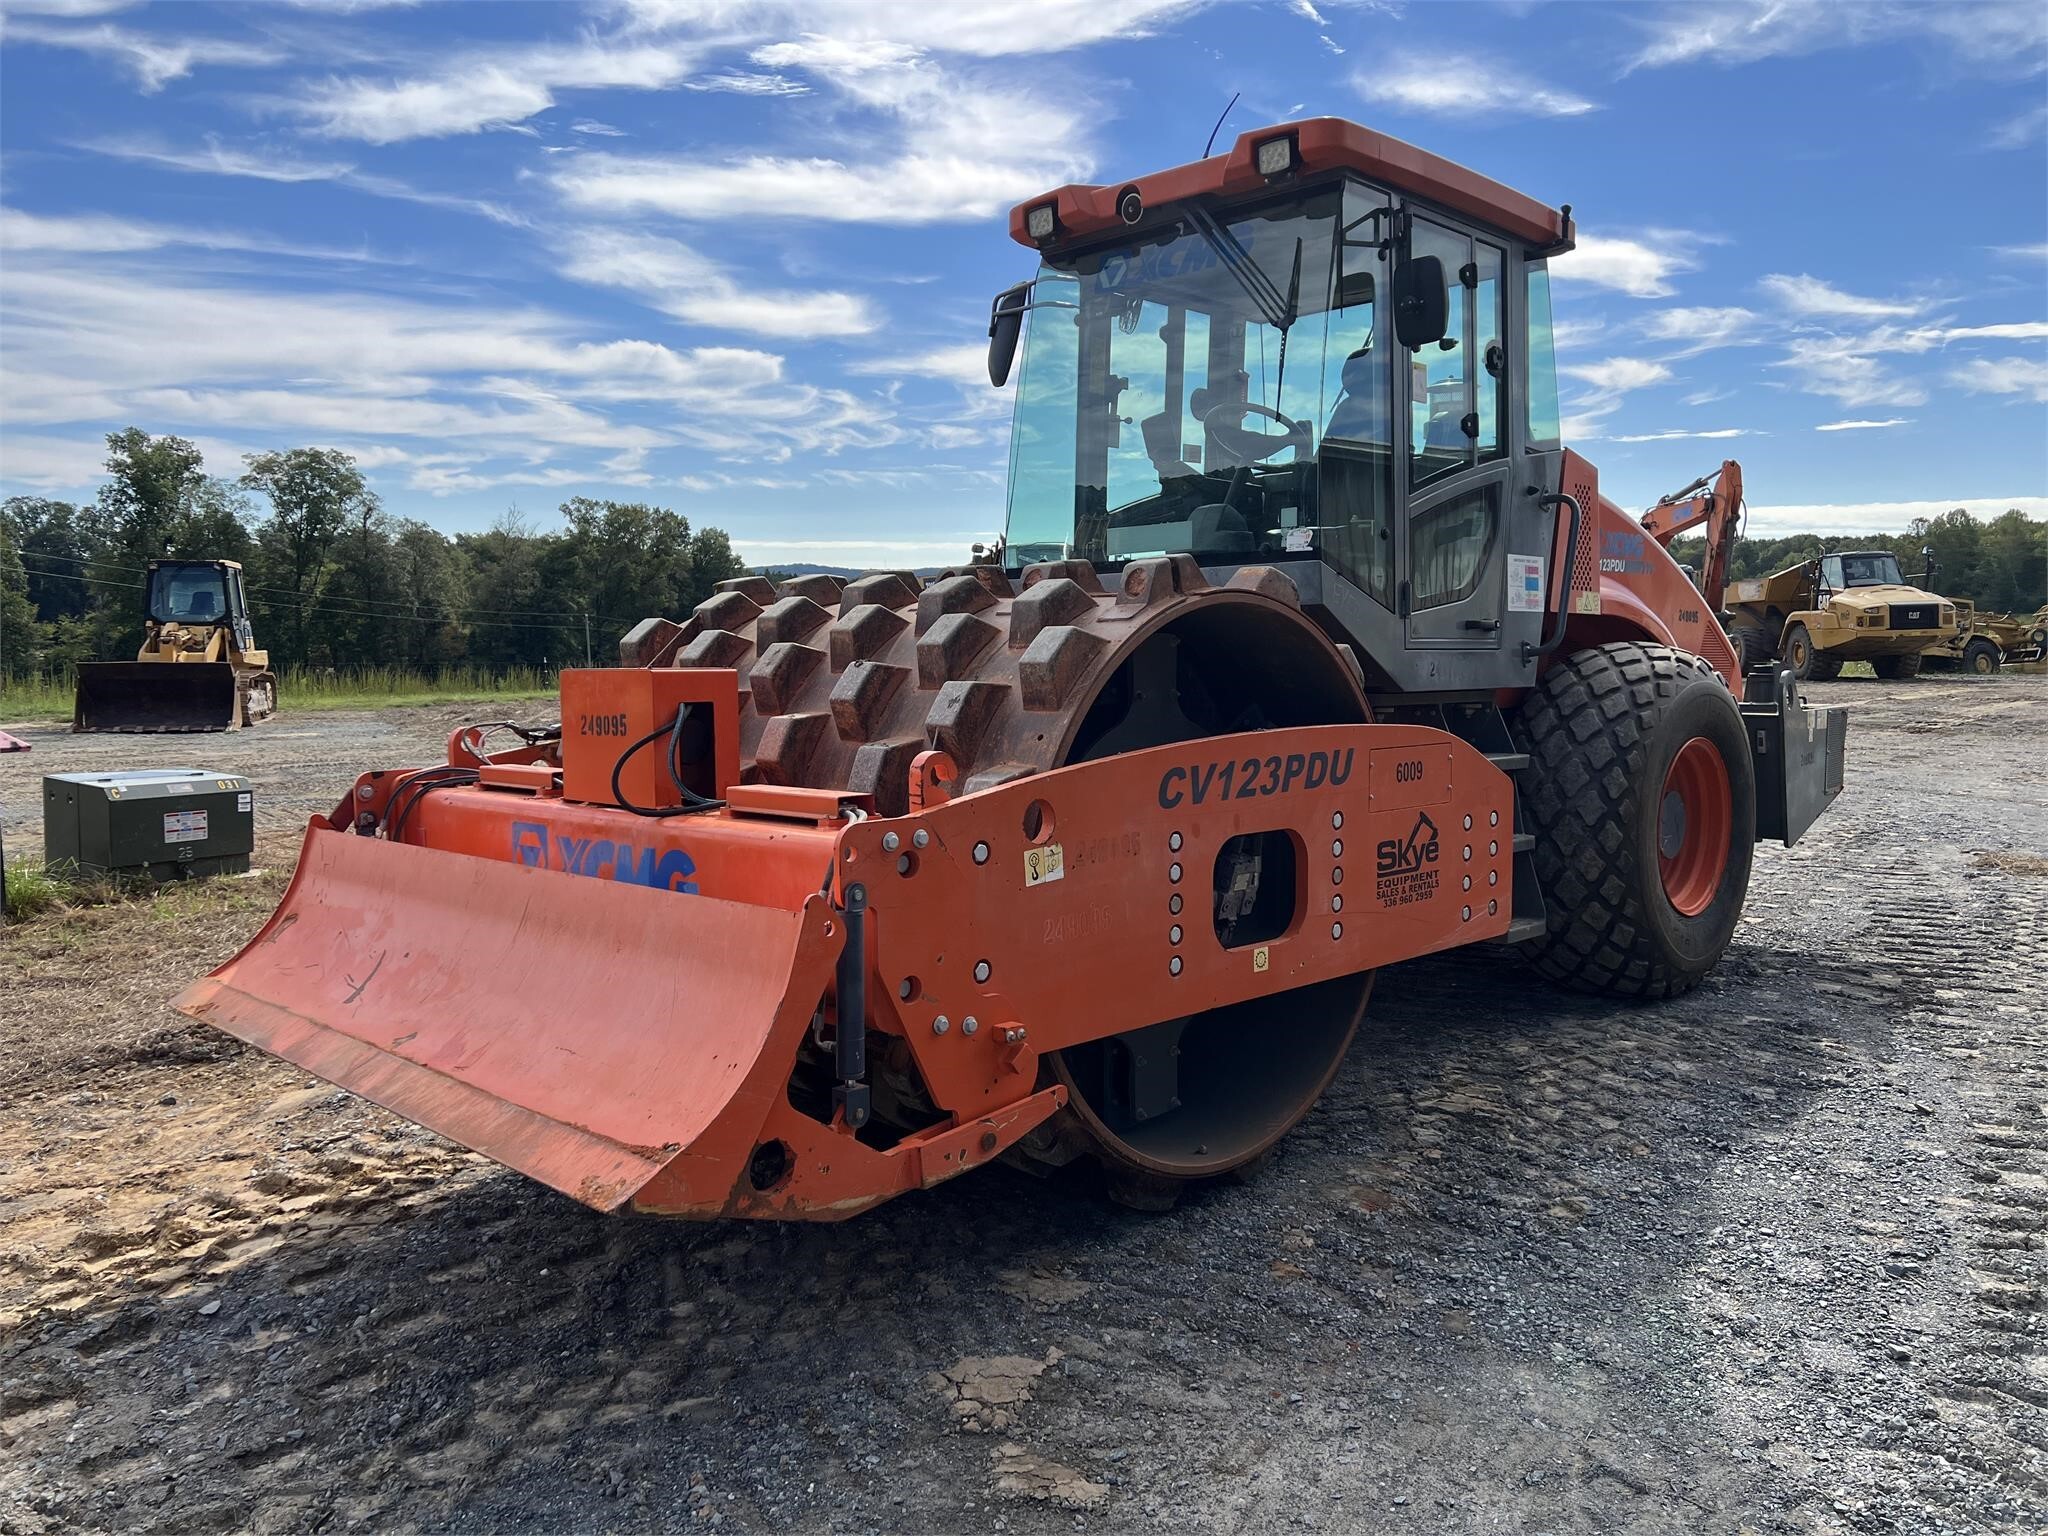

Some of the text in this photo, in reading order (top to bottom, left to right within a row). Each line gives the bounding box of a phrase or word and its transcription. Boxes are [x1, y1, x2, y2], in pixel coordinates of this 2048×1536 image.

[580, 713, 628, 737] 249095
[1158, 748, 1355, 810] CV123PDU
[1396, 760, 1424, 784] 6009
[218, 780, 240, 790] 031
[556, 836, 699, 895] XCMG
[1376, 869, 1440, 890] EQUIPMENT
[1376, 879, 1440, 900] SALES & RENTALS
[1383, 890, 1433, 908] 336 960 2959
